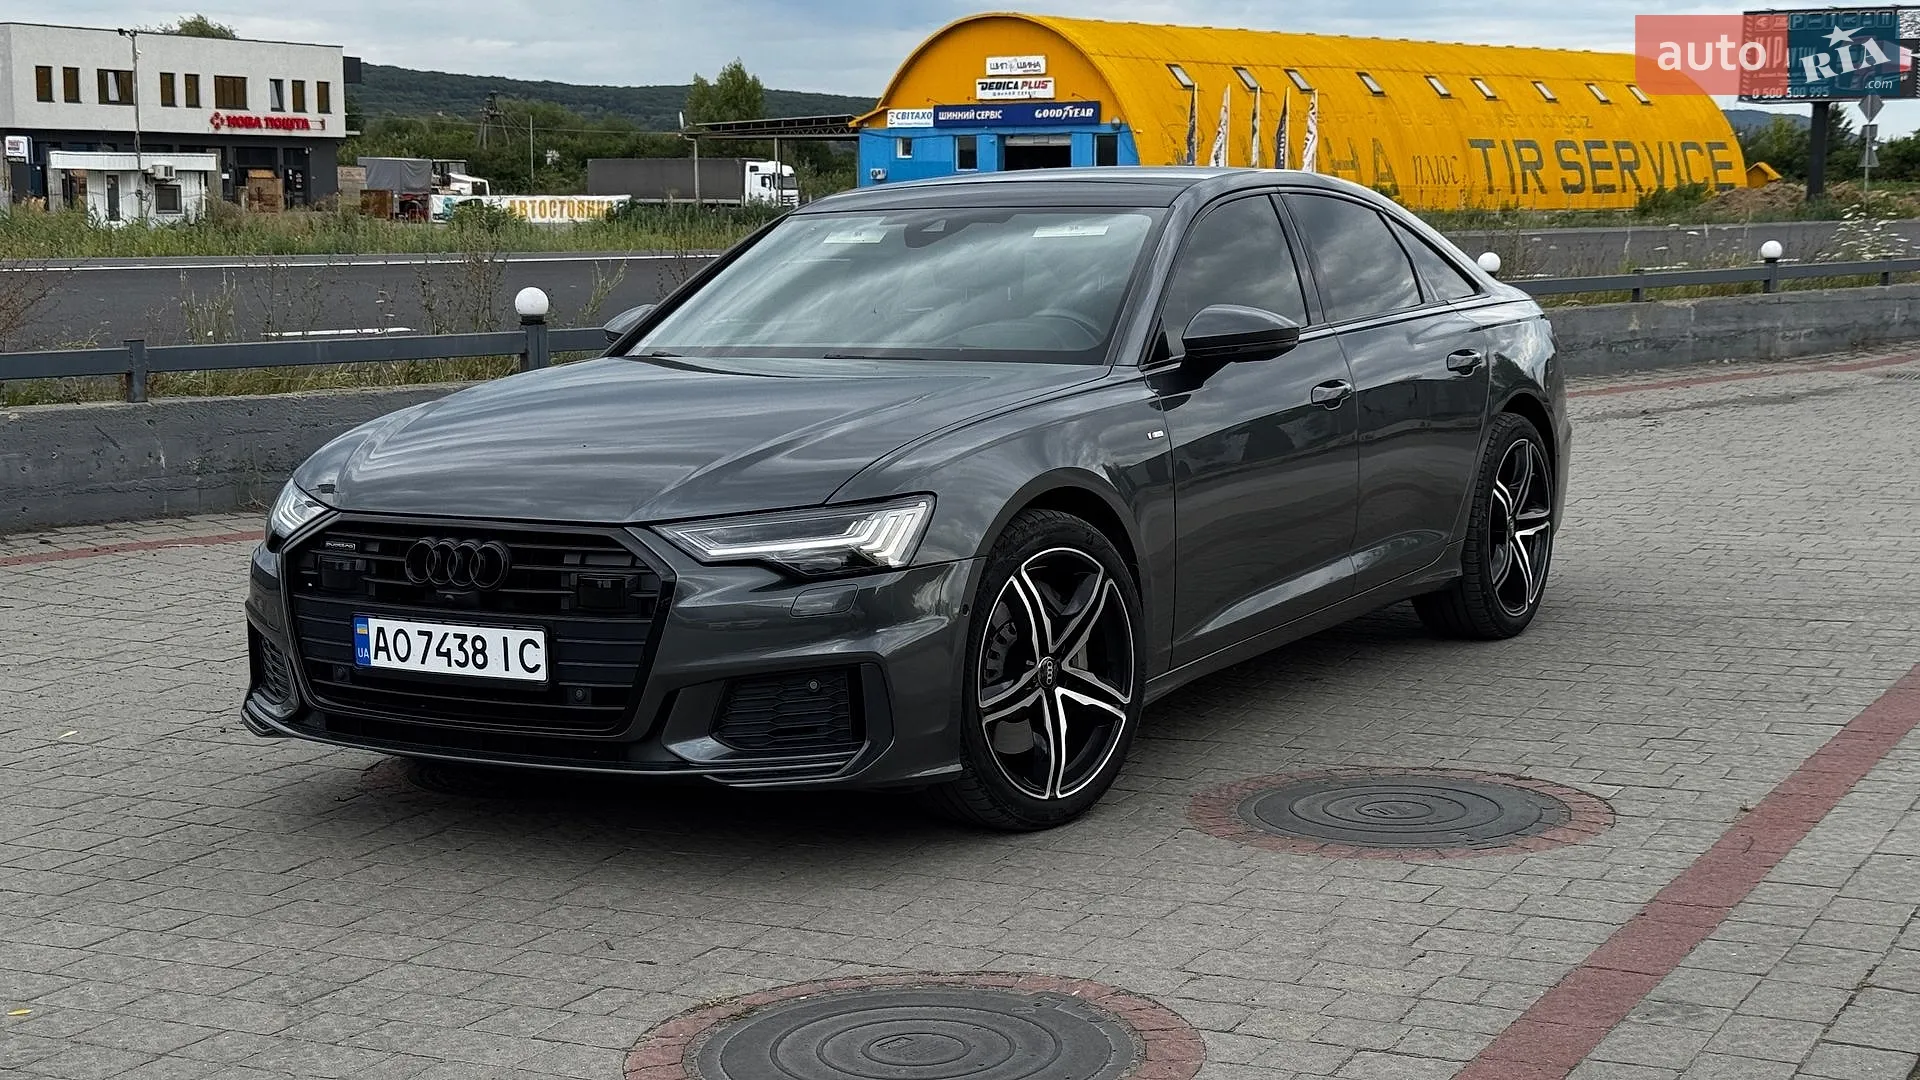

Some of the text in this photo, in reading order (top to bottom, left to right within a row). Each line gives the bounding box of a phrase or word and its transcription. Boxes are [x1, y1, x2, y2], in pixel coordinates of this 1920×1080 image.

[977, 80, 1052, 91] DEDICA PLUS
[938, 108, 1003, 120] ШИННИЙ СЕРВІС
[1034, 105, 1094, 120] GOODYEAR
[226, 116, 310, 131] НОВА ПОШТА
[1468, 138, 1738, 195] TIR SERVICE
[357, 647, 370, 659] UA
[417, 629, 488, 670] 7438
[502, 636, 541, 674] IC
